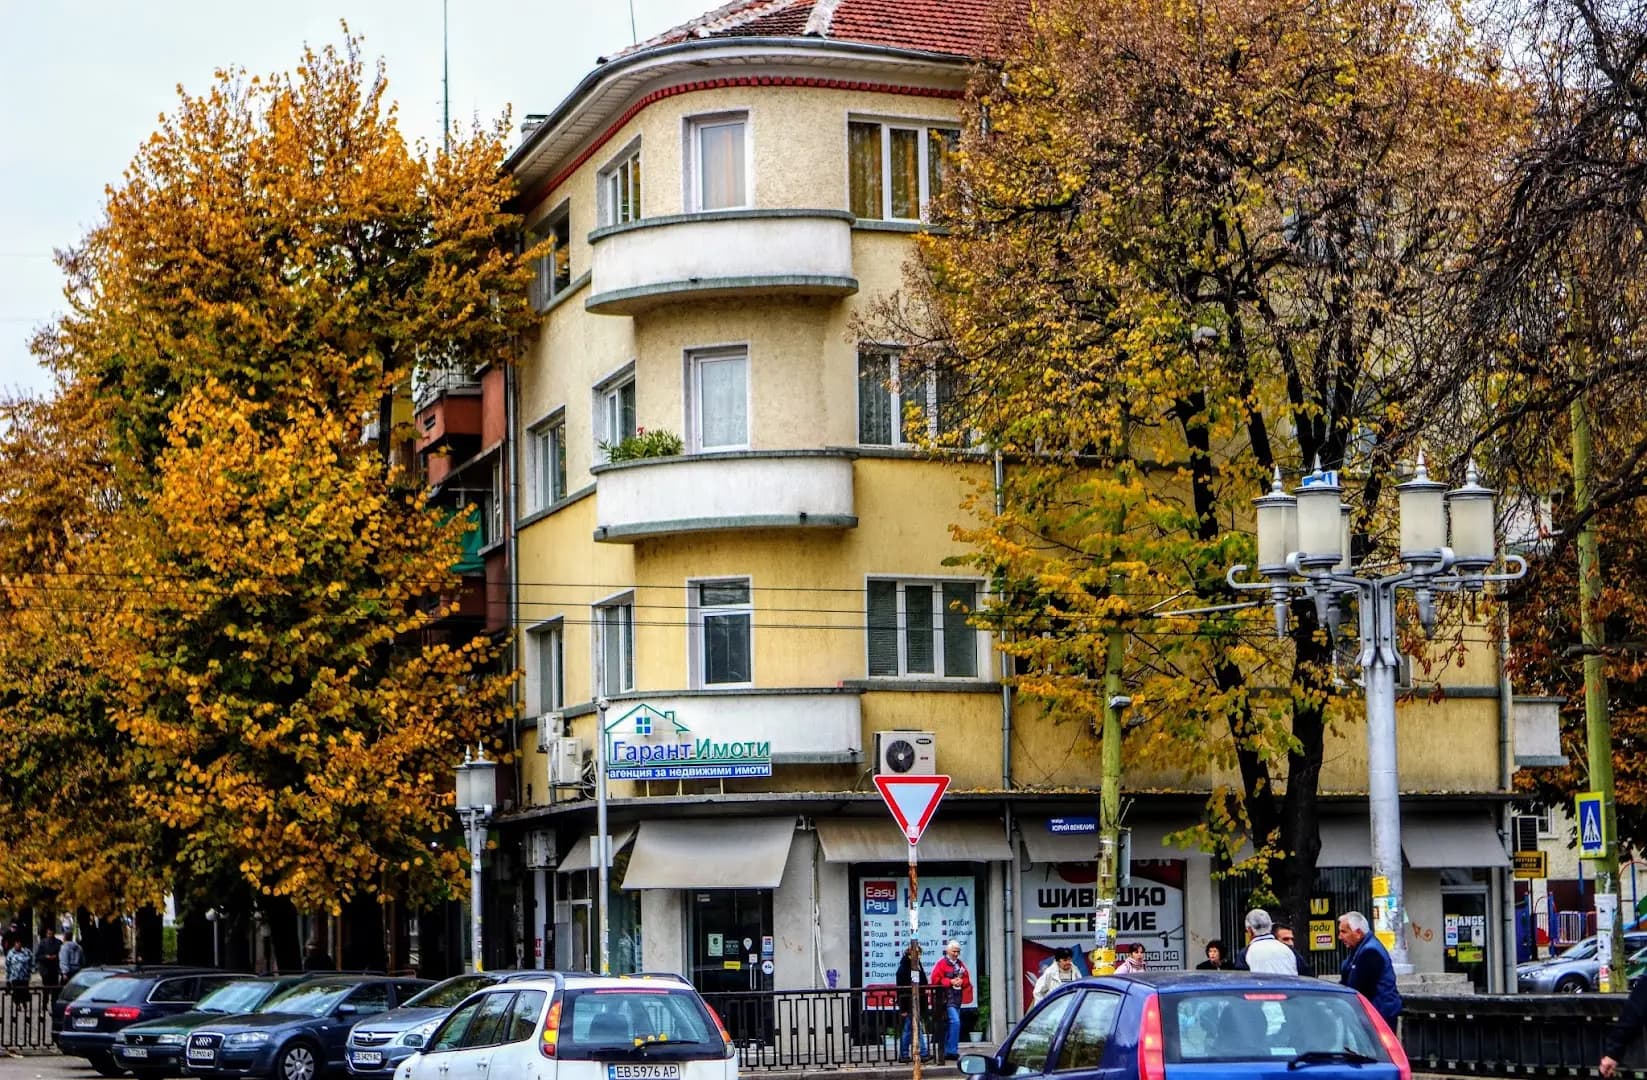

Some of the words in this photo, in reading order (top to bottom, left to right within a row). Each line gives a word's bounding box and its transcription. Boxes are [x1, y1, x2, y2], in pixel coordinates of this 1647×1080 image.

[613, 741, 692, 765] Гарант
[696, 738, 770, 759] Имоти
[609, 768, 653, 779] агенция
[655, 769, 667, 777] за
[669, 767, 732, 778] недвижими
[734, 766, 769, 775] имоти
[865, 887, 895, 900] Easy
[1038, 887, 1166, 908] ШИВШКО
[866, 900, 889, 912] Pay
[1051, 912, 1156, 932] АТЕИЕ
[1445, 915, 1485, 926] CHANGE
[1163, 951, 1178, 960] на
[663, 1066, 677, 1078] AP
